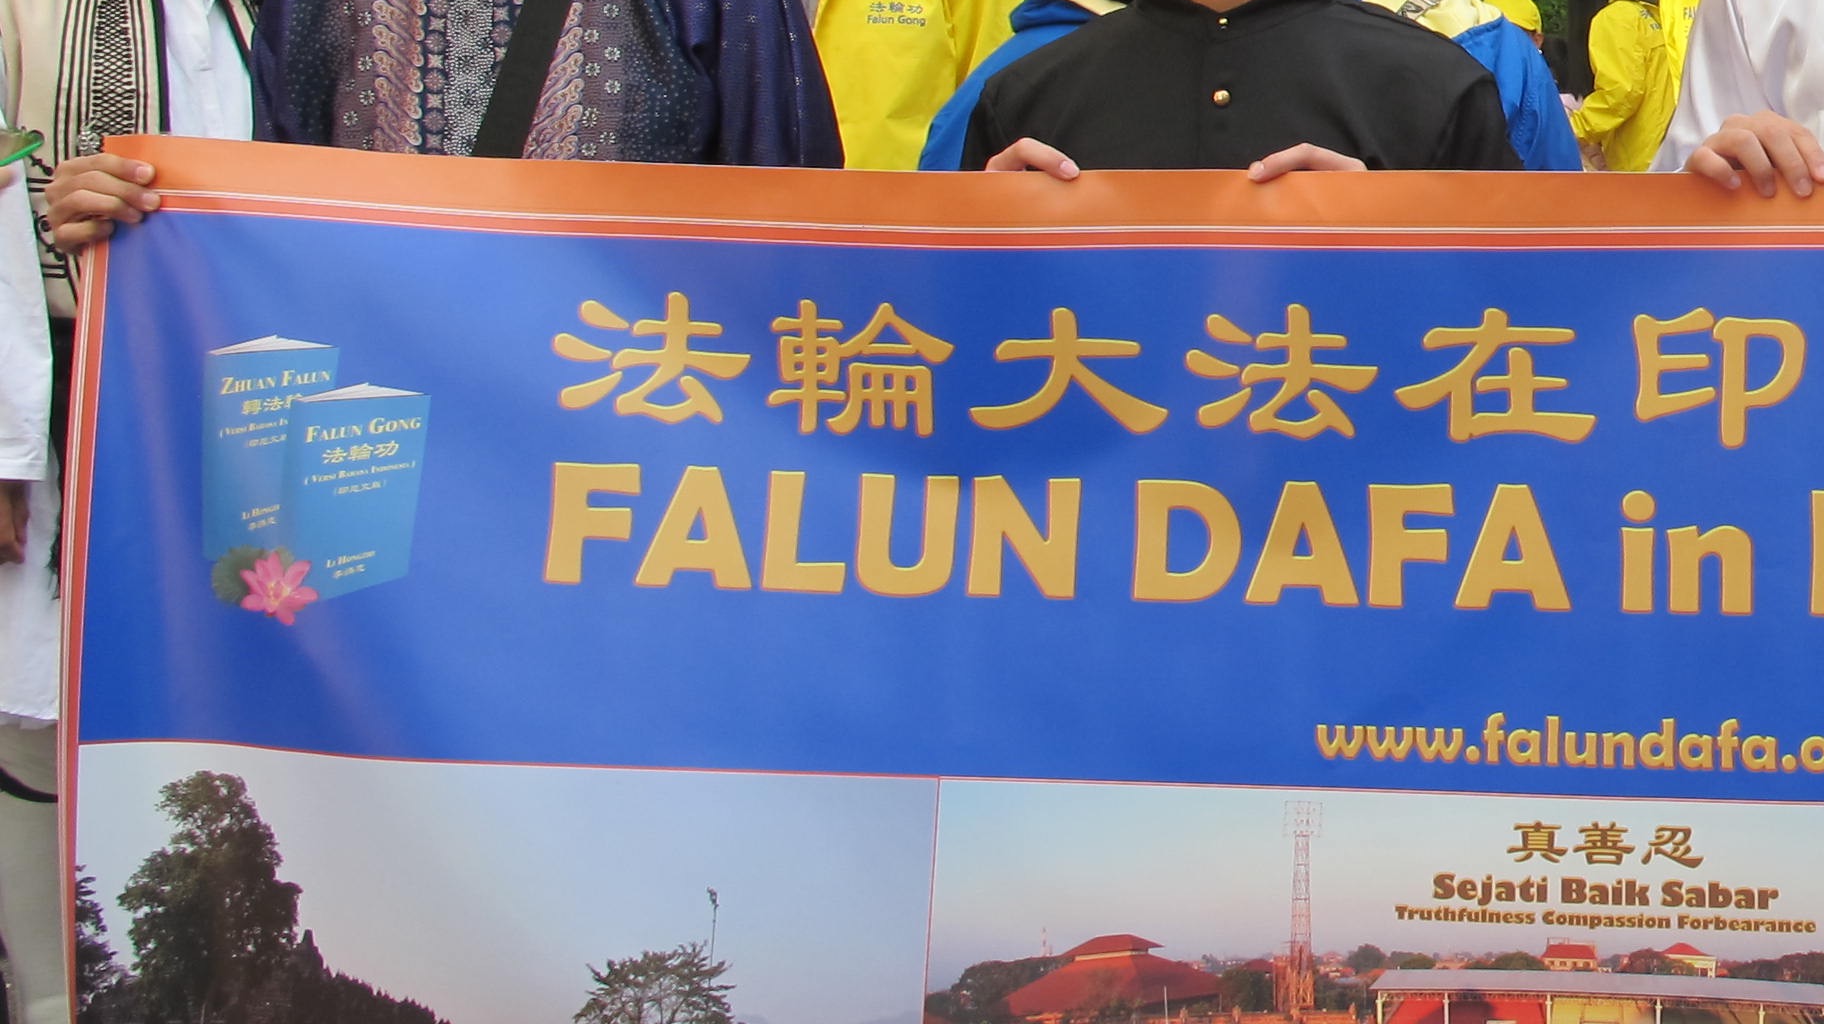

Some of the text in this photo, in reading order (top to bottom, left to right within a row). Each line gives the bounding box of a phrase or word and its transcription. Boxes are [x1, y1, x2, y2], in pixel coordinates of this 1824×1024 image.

[867, 14, 927, 27] Falun Gong
[321, 439, 400, 465] 法輪功
[544, 463, 1081, 599] FALUN
[1133, 480, 1571, 611] DAFA
[1620, 490, 1753, 616] in
[1506, 821, 1704, 868] 真善忍
[1432, 872, 1780, 910] Sejati Baik Sabar
[1394, 905, 1818, 934] Truthfulness Compassion Forbearance
